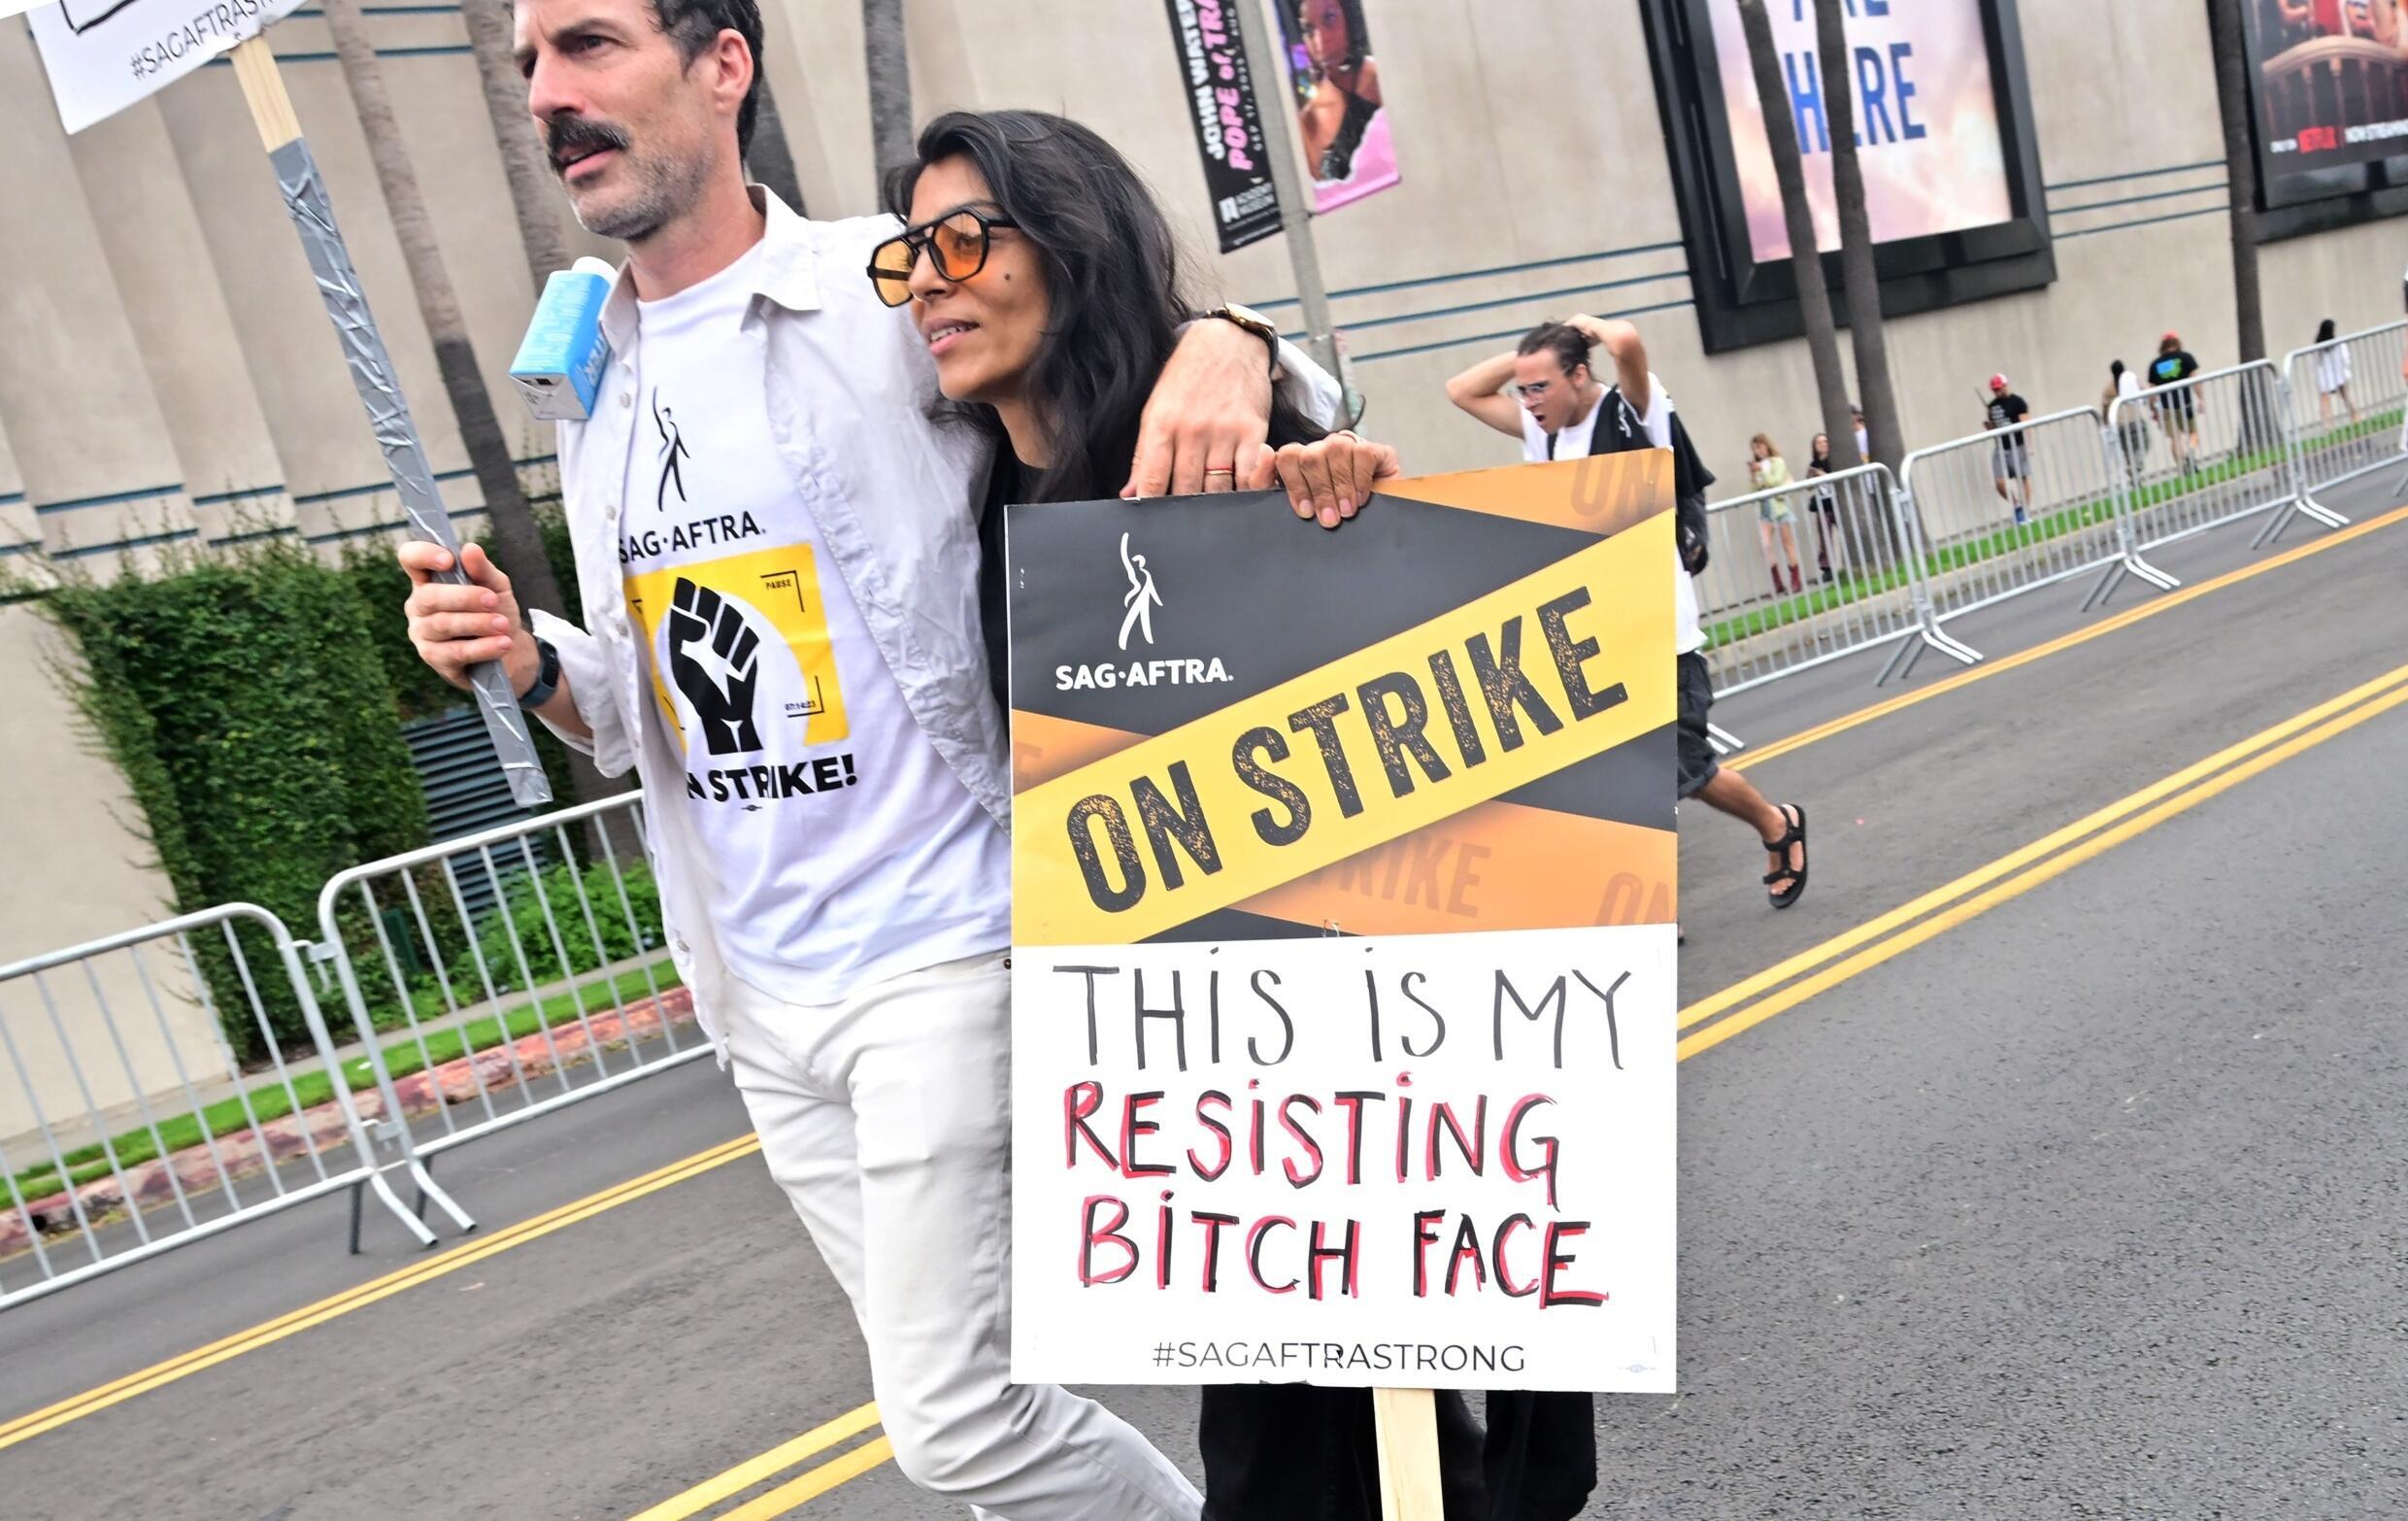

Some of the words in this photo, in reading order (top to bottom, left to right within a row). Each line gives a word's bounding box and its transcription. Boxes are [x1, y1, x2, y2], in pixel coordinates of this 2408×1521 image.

[1193, 84, 1225, 160] JOHN
[1216, 86, 1254, 171] POPE
[1785, 42, 1926, 155] HRE
[1066, 760, 1223, 913] ON
[1232, 586, 1629, 847] STRIKE
[1493, 968, 1632, 1069] MY
[1413, 1208, 1610, 1309] FACE
[1153, 1341, 1525, 1372] #SAGAFTRASTRONG
